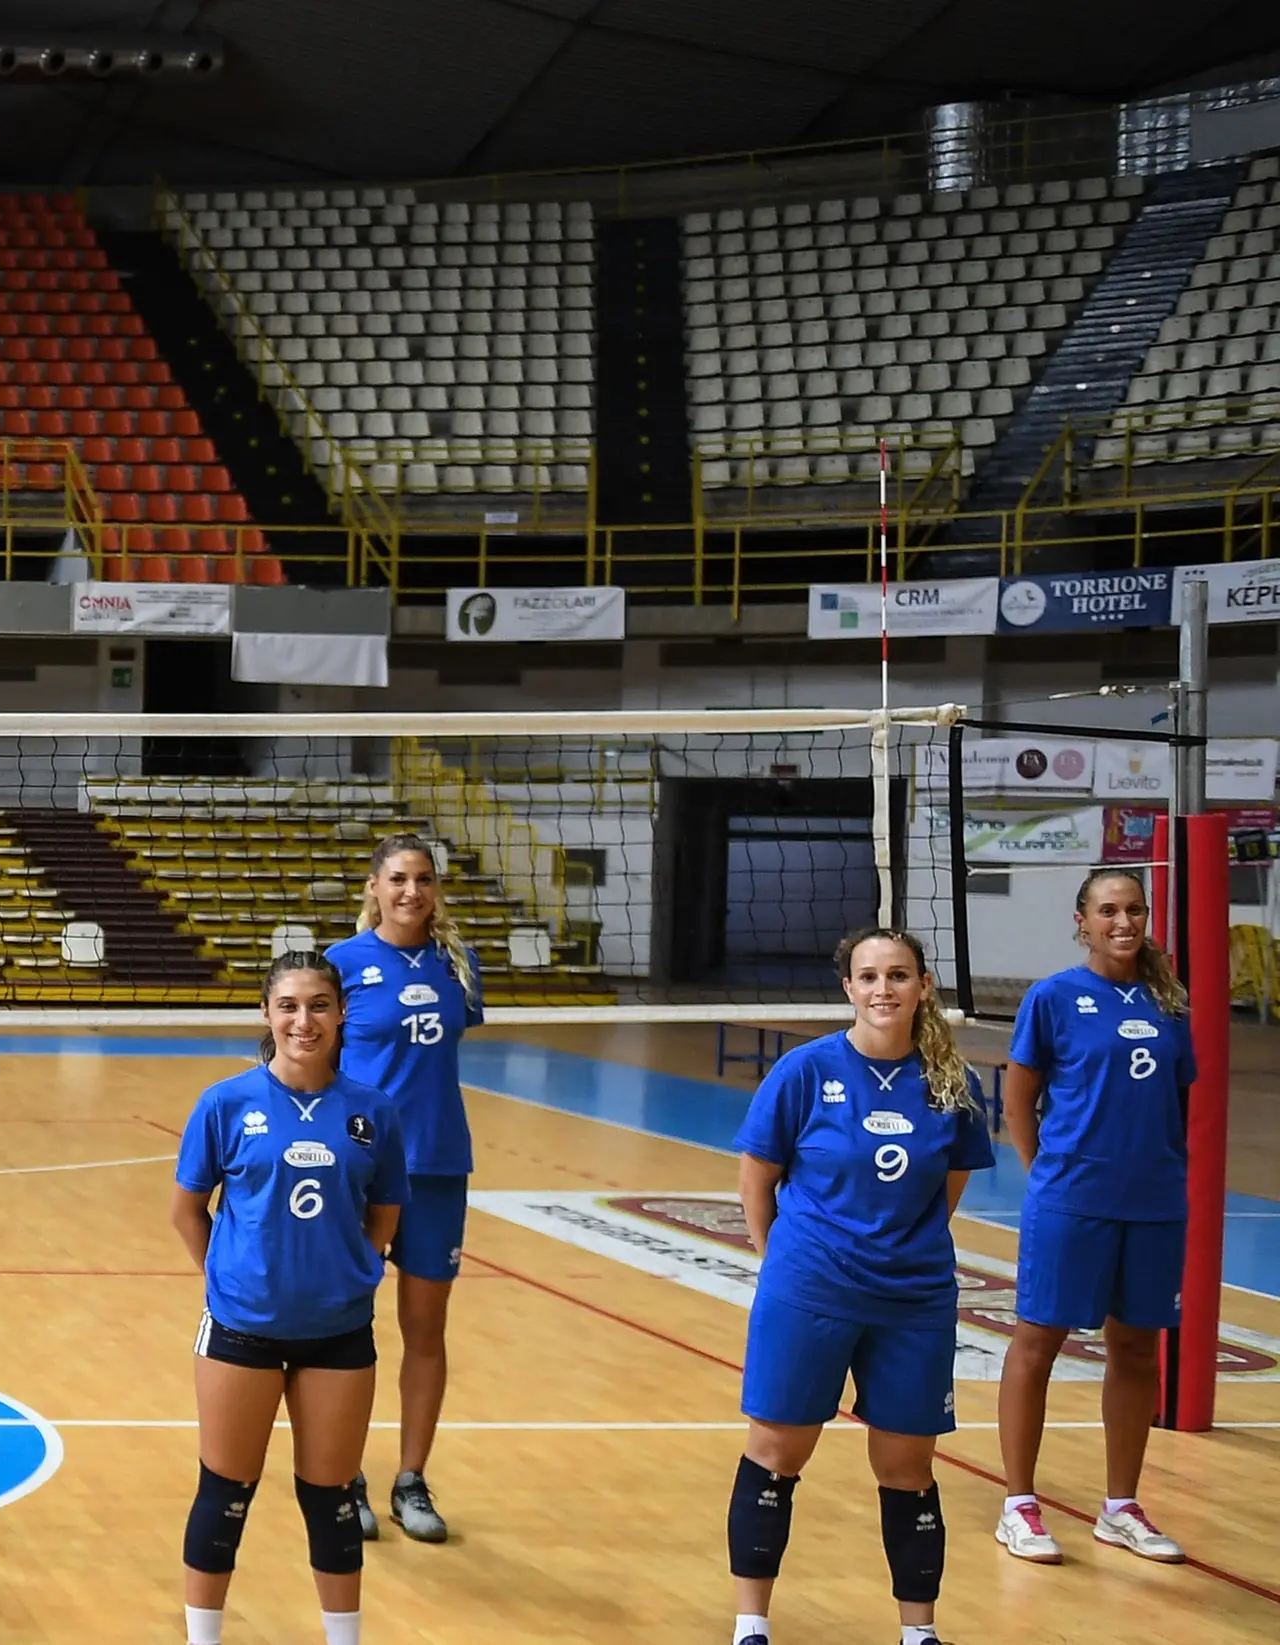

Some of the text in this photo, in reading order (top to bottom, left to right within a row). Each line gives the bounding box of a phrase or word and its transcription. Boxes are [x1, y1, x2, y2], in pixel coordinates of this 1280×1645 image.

[895, 588, 940, 606] CRM
[1051, 574, 1167, 597] TORRIONE
[79, 596, 132, 609] OMNIA
[1071, 593, 1147, 614] HOTEL
[401, 1012, 443, 1045] 13
[1129, 1047, 1157, 1080] 8
[874, 1143, 909, 1183] 9
[289, 1178, 323, 1219] 6
